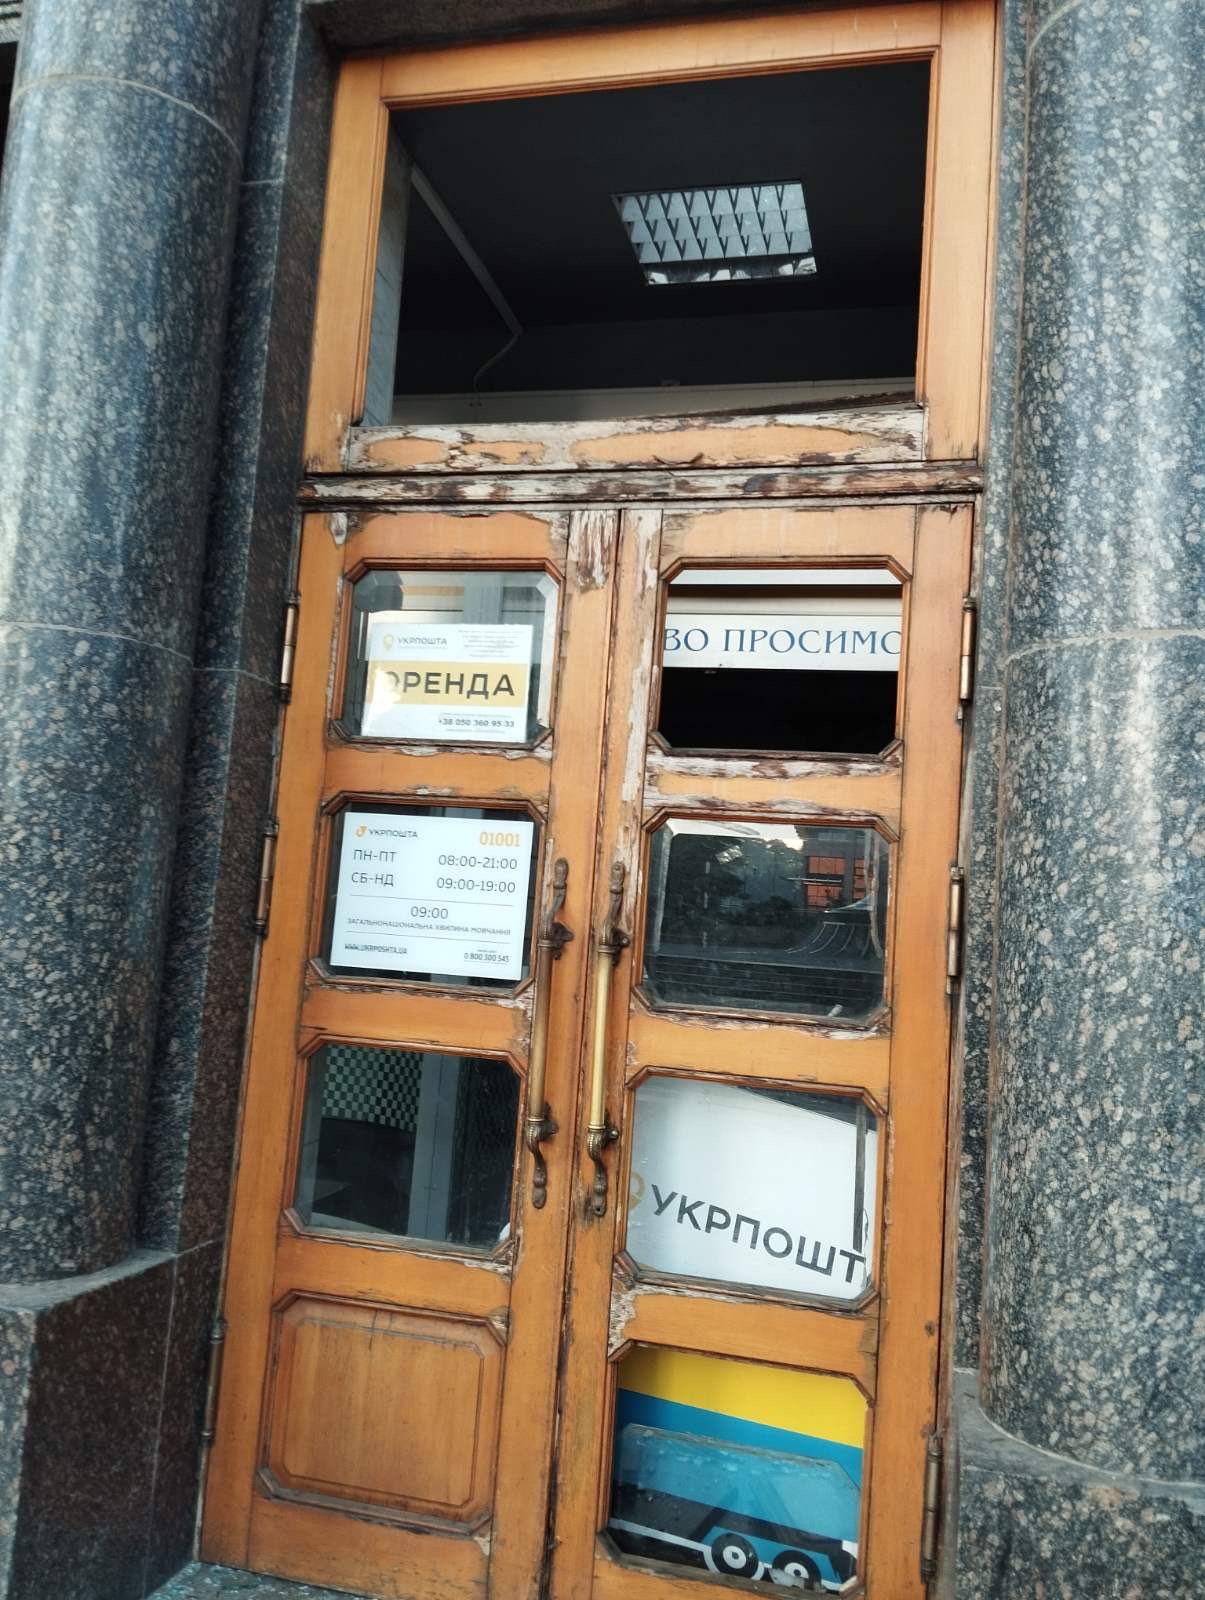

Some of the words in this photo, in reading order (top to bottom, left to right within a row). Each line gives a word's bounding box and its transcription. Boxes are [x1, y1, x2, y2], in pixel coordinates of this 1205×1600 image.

[398, 637, 447, 646] УКРПОШТА
[369, 828, 418, 838] УКРПОШТА
[479, 831, 520, 847] 01001
[353, 849, 397, 863] ПН-ПТ
[438, 854, 518, 870] 08:00-21:00
[351, 872, 394, 887] СБ-НД
[436, 877, 516, 893] 09:00-19:00
[410, 905, 449, 920] 09:00
